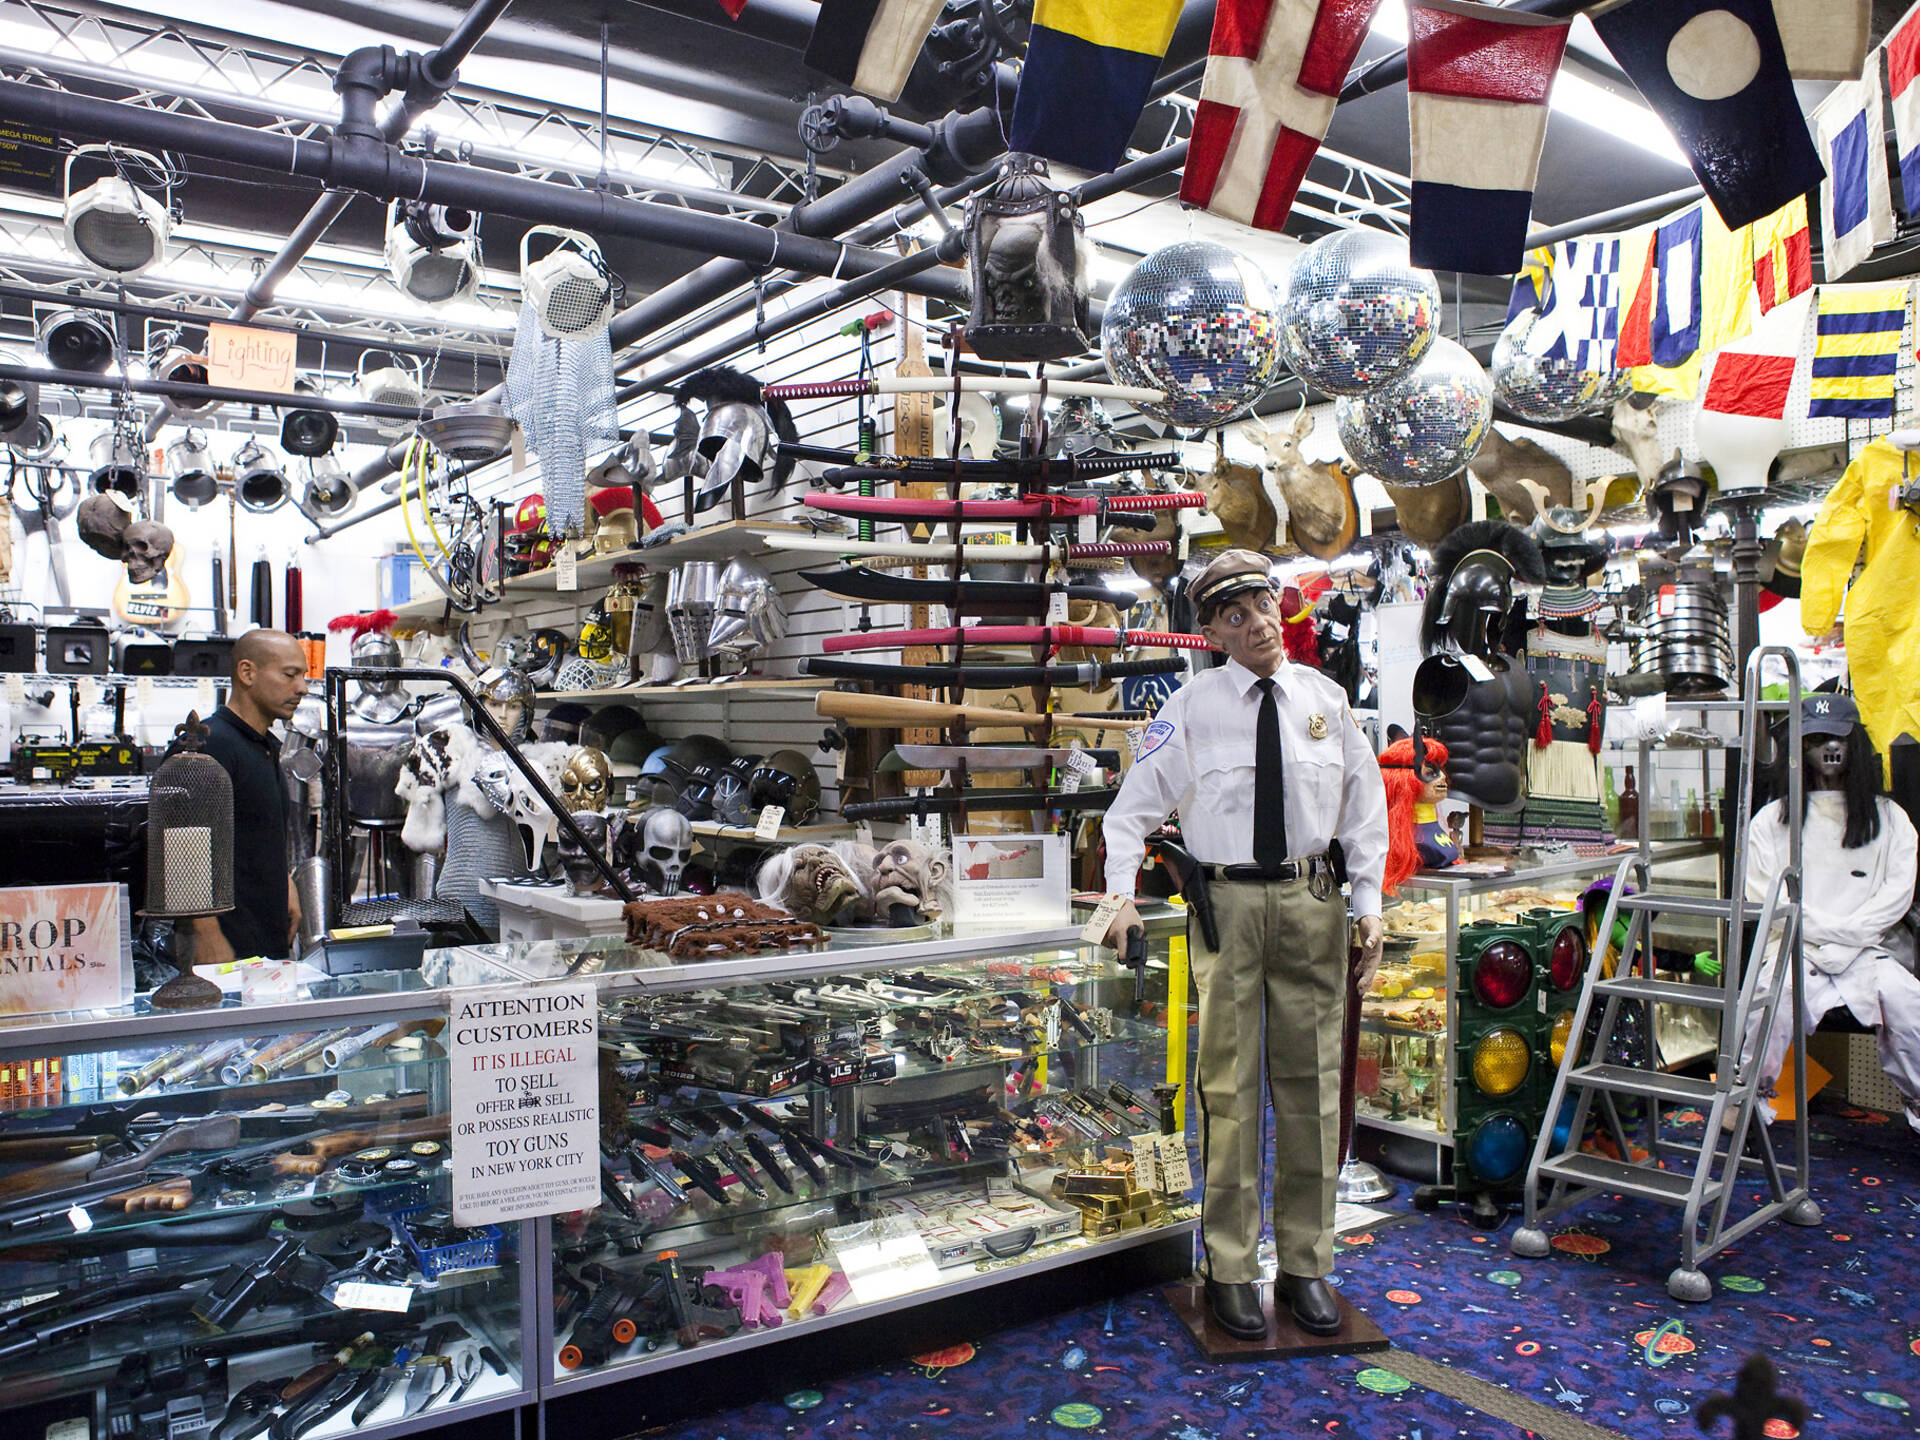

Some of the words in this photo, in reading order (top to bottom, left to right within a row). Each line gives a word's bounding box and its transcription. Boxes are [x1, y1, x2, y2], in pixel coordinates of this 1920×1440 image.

[211, 335, 292, 389] Lighting
[128, 603, 159, 616] ELVIS
[1815, 700, 1830, 713] NY
[0, 953, 86, 975] NTALS
[459, 994, 586, 1020] ATTENTION
[456, 1018, 593, 1046] CUSTOMERS
[472, 1055, 488, 1072] IT
[492, 1053, 506, 1070] IS
[510, 1047, 577, 1068] ILLEGAL
[495, 1077, 516, 1093] TO
[521, 1072, 558, 1091] SELL
[769, 1071, 784, 1086] JLS
[830, 1064, 852, 1079] JLS
[476, 1098, 515, 1115] OFFER
[545, 1092, 574, 1107] SELL
[457, 1123, 476, 1136] OR
[478, 1115, 530, 1134] POSSESS
[533, 1107, 595, 1126] REALISTIC
[486, 1137, 520, 1158] TOY
[524, 1132, 569, 1153] GUNS
[471, 1166, 485, 1179] IN
[487, 1161, 516, 1177] NEW
[518, 1155, 553, 1172] YORK
[555, 1151, 584, 1167] CITY
[502, 1185, 526, 1195] QUESTION
[527, 1182, 544, 1191] ABOUT
[480, 1198, 499, 1207] REPORT
